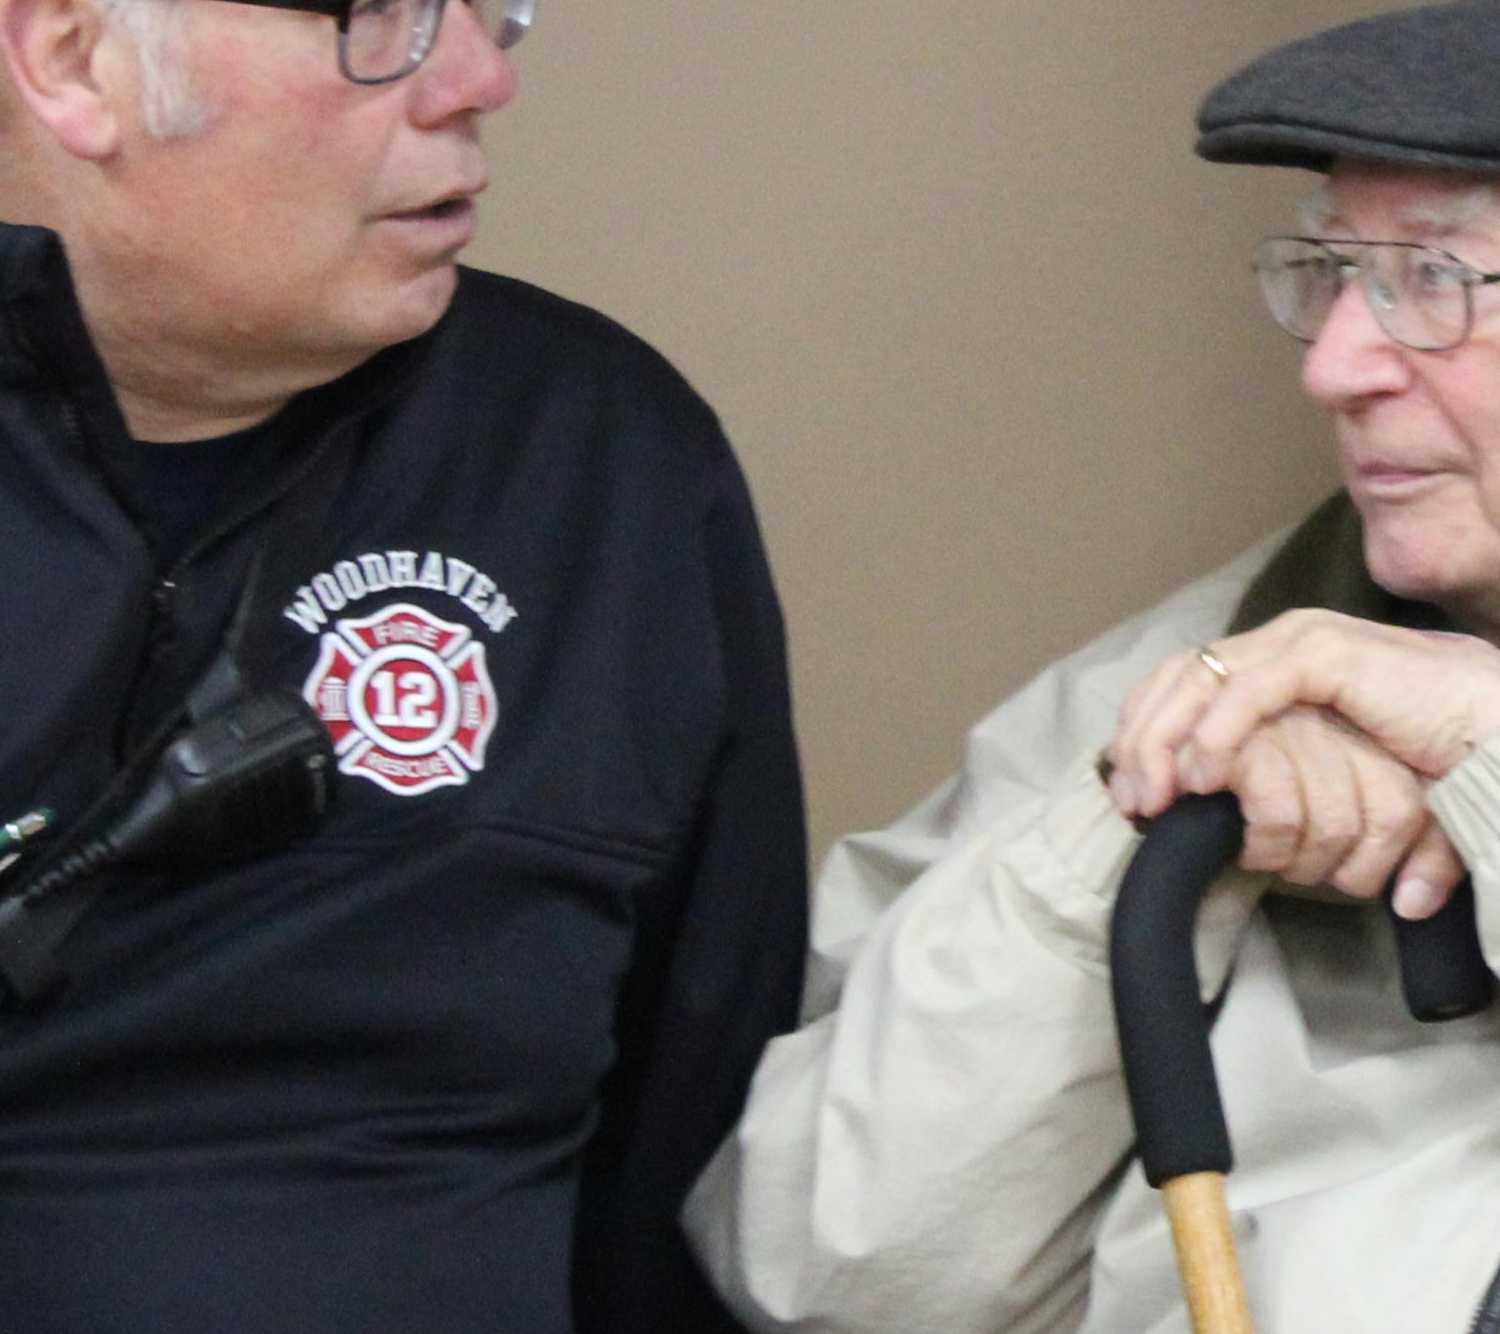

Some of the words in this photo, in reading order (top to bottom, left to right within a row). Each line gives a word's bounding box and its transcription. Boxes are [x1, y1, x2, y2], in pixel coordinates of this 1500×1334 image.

[283, 550, 520, 634] WOODHAVEN
[371, 619, 443, 649] FIRE
[368, 670, 440, 729] 12
[363, 751, 451, 779] RESCUE
